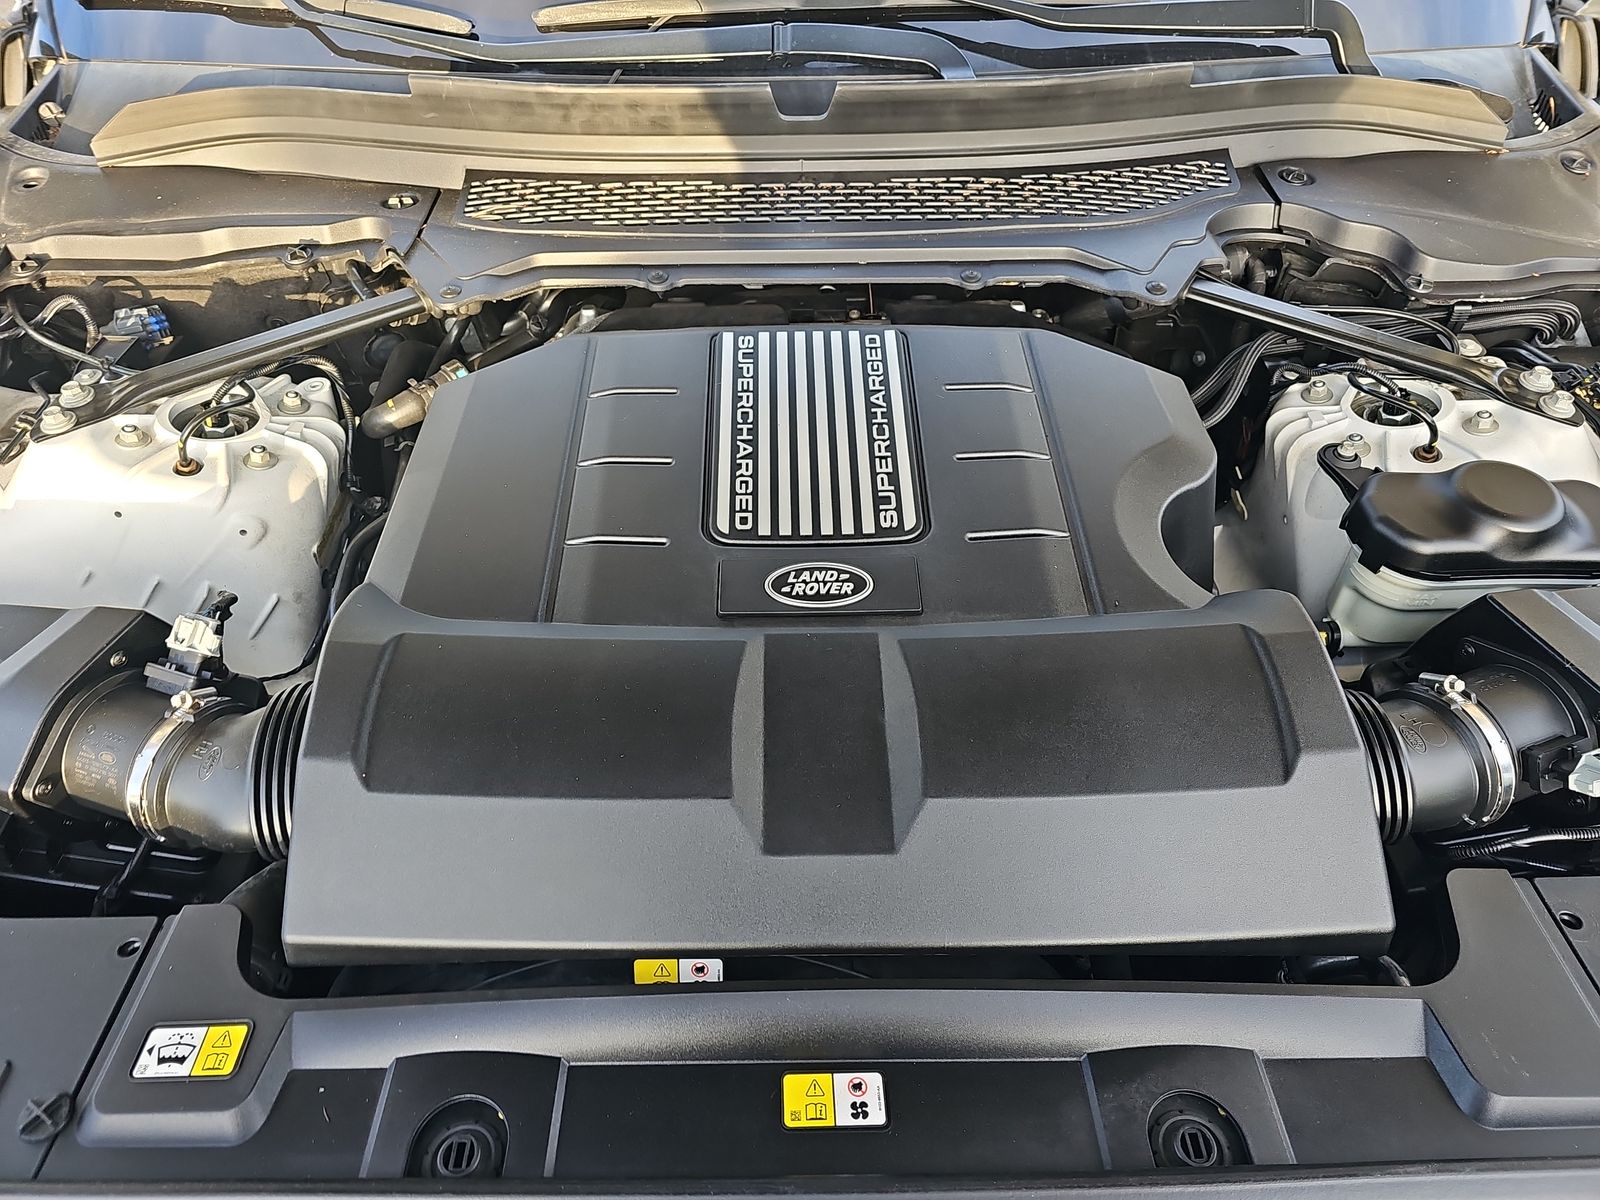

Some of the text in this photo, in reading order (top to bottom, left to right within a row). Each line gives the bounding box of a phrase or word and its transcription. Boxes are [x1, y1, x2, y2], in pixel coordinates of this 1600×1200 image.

[735, 335, 754, 530] SUPERCHARGED
[865, 333, 899, 529] SUPERCHARGED
[787, 570, 839, 583] LAND
[791, 582, 855, 596] ROVER
